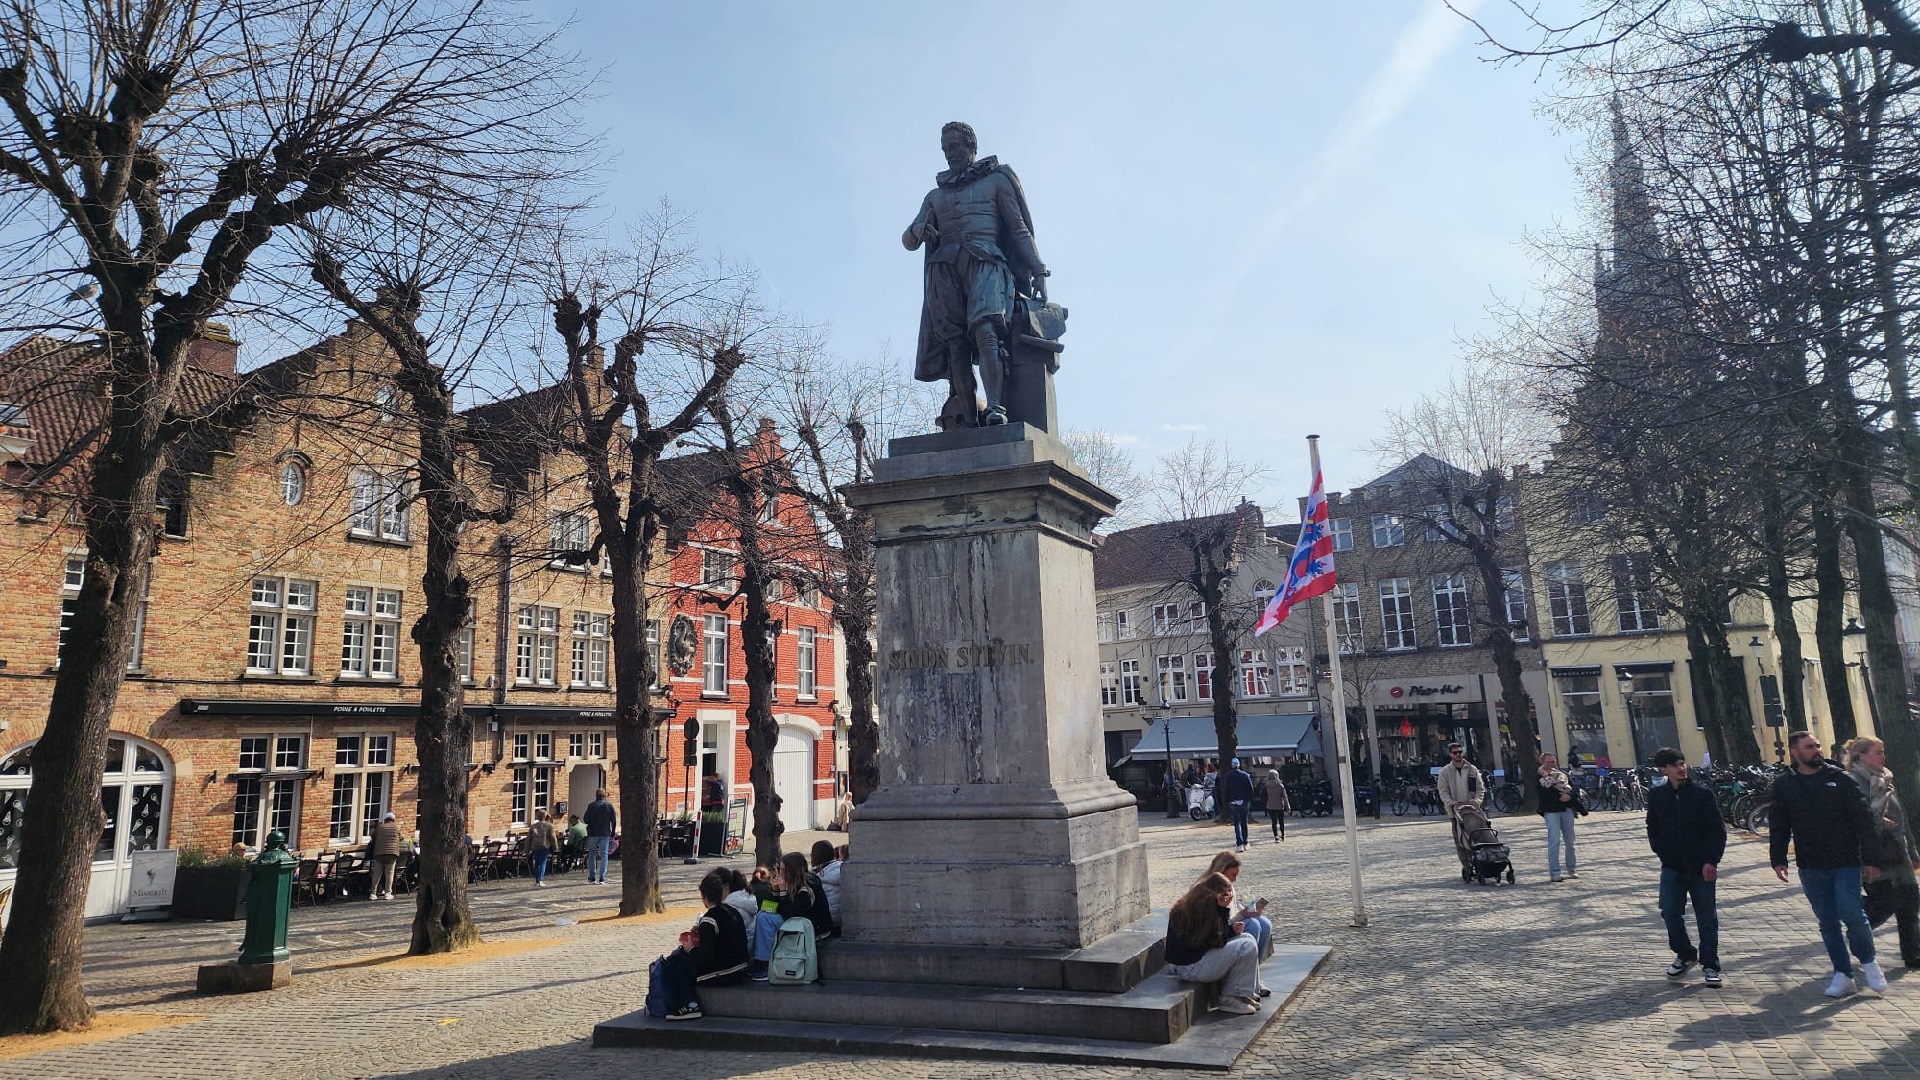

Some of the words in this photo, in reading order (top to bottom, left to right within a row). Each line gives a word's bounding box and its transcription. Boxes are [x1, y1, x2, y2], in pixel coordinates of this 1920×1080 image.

[889, 648, 949, 671] SIMON
[1409, 685, 1439, 697] Pizza
[1440, 684, 1464, 695] Hut
